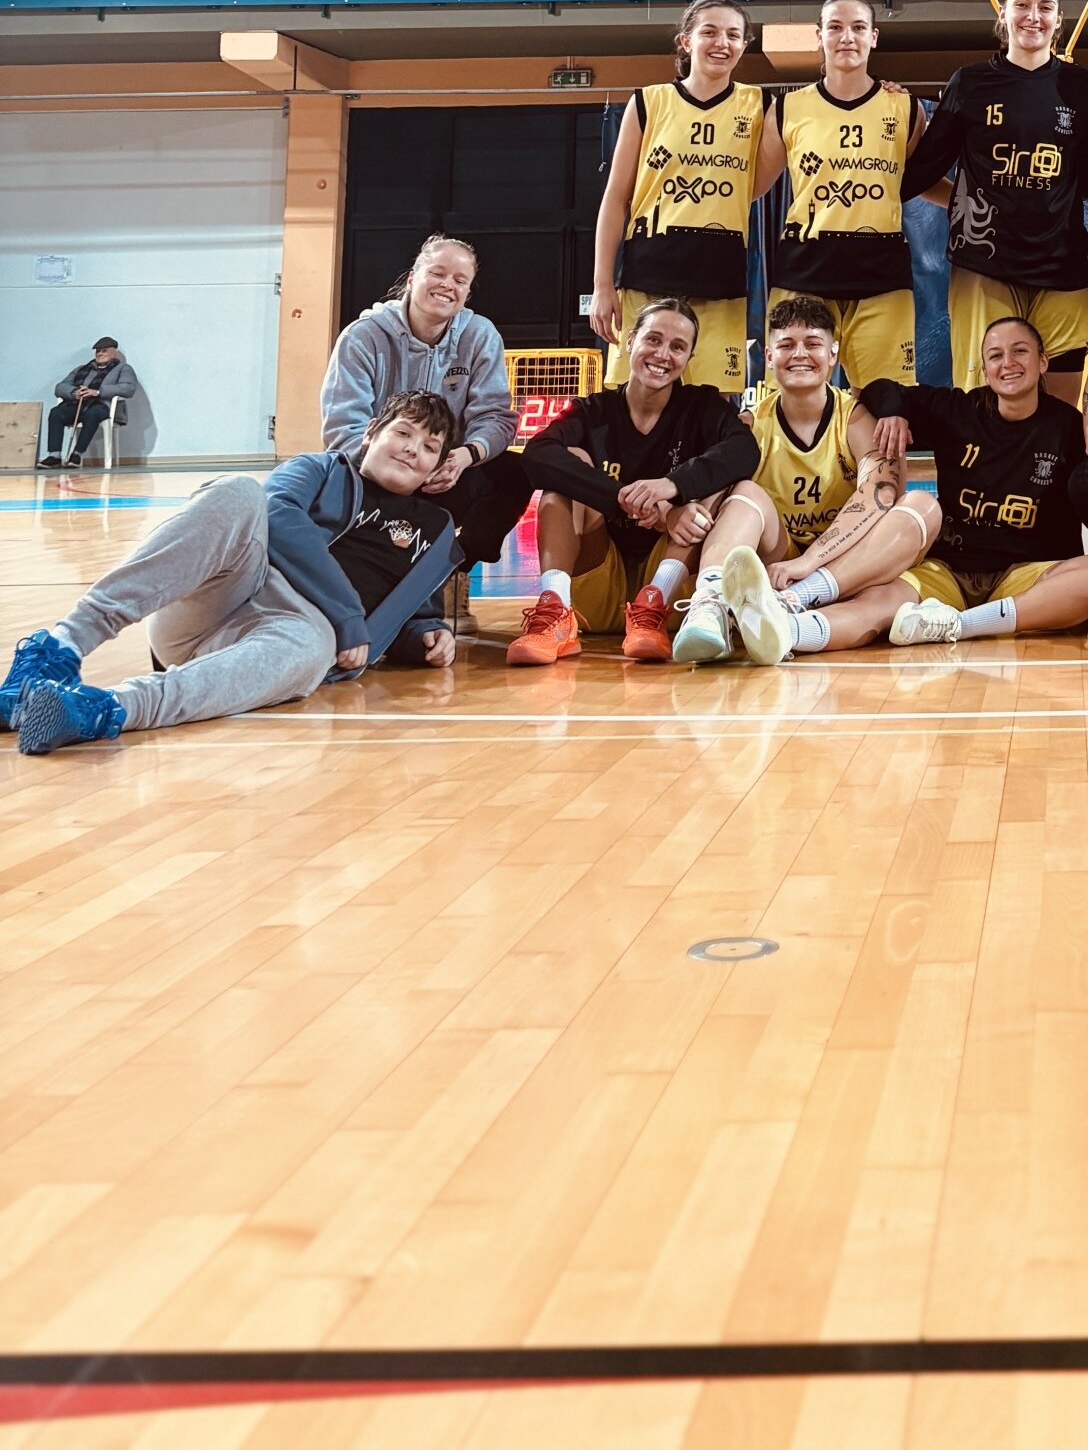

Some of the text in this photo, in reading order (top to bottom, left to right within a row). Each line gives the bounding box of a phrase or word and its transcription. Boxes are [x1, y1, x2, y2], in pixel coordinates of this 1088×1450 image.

[986, 103, 1004, 126] 15
[690, 122, 715, 145] 20
[839, 125, 863, 148] 23
[678, 153, 749, 172] WAMGROU
[663, 176, 734, 204] axpo
[991, 174, 1051, 190] FITNESS
[814, 180, 884, 208] axpo
[960, 443, 980, 468] 11
[794, 475, 822, 505] 24
